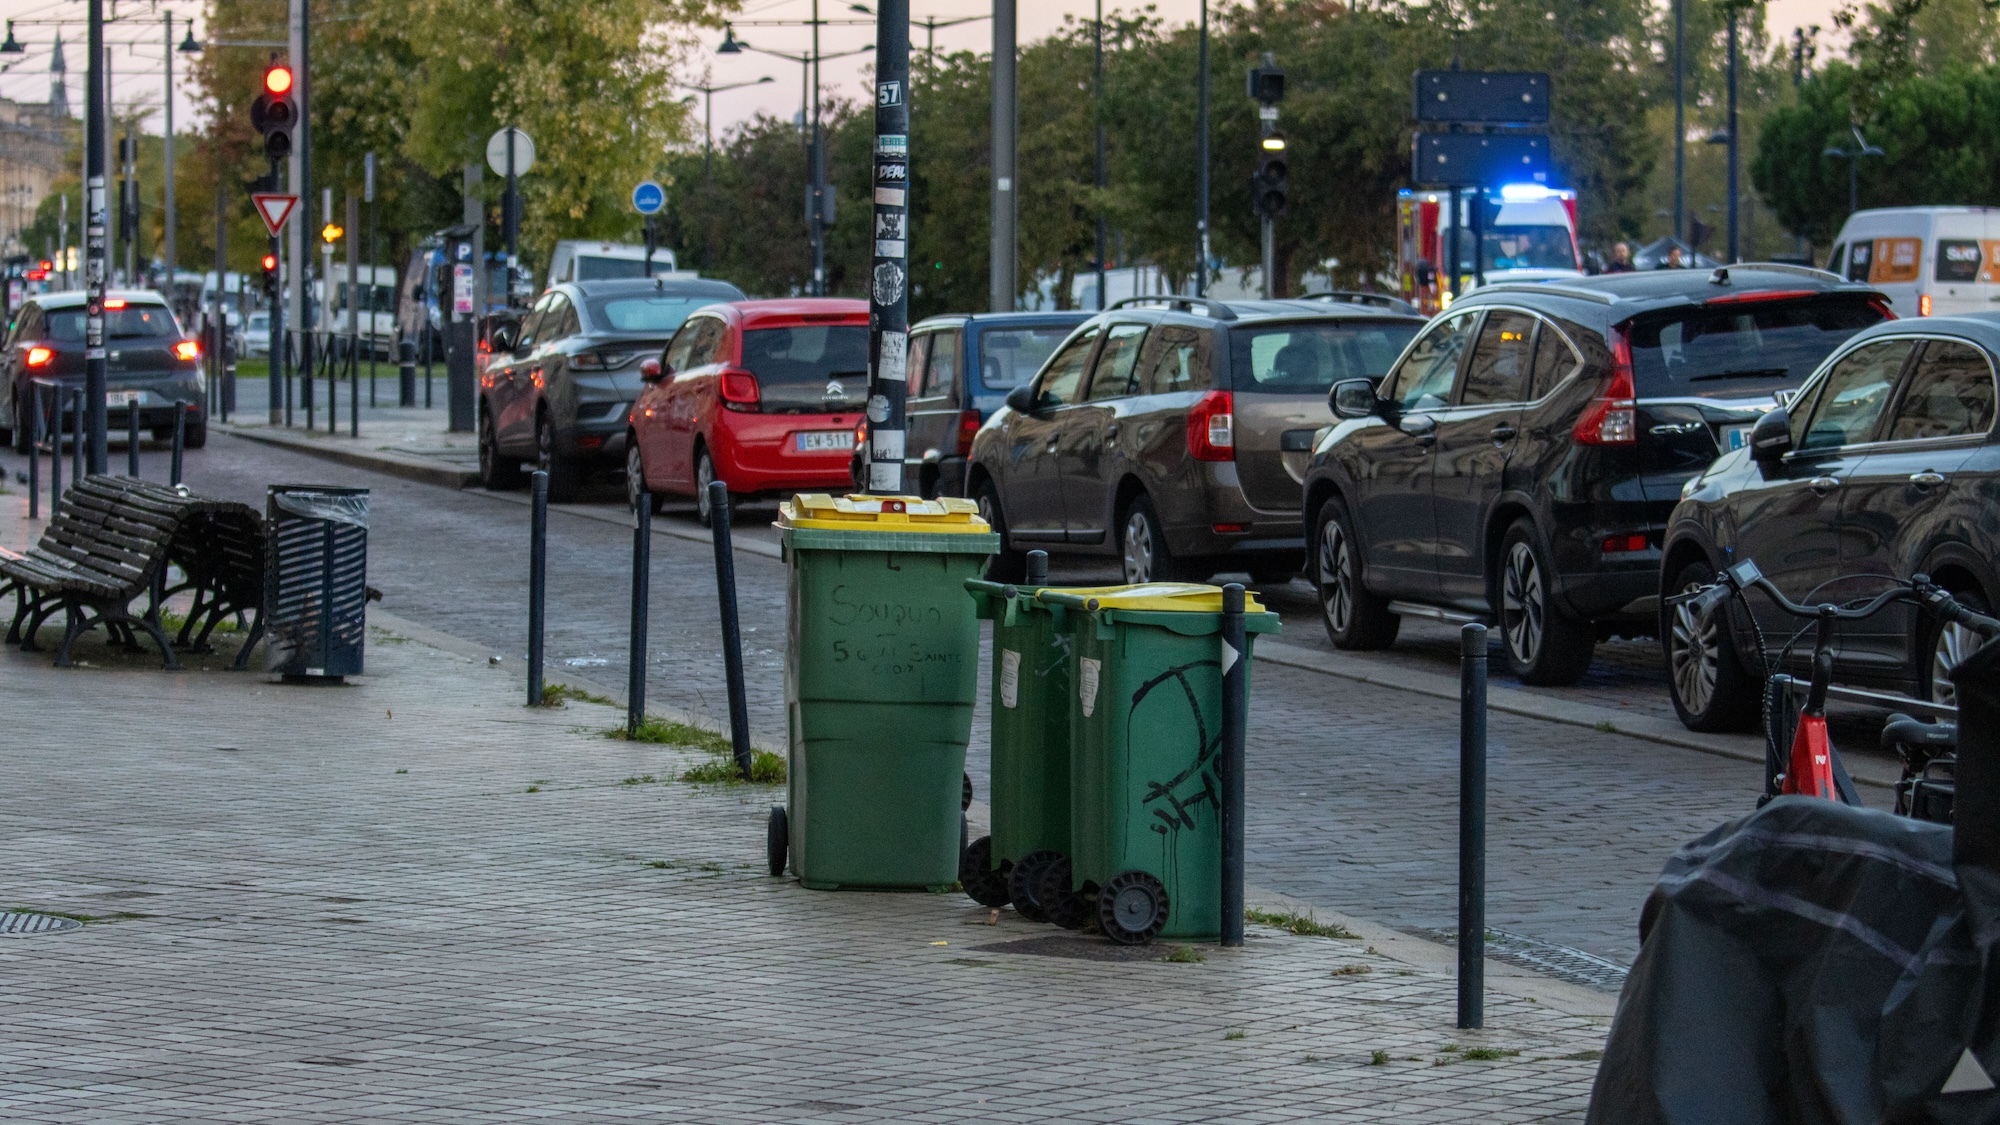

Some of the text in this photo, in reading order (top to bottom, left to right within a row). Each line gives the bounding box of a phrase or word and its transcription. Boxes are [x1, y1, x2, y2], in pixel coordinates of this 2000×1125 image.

[880, 84, 898, 104] 57
[879, 164, 906, 179] DEAL
[458, 243, 471, 260] P
